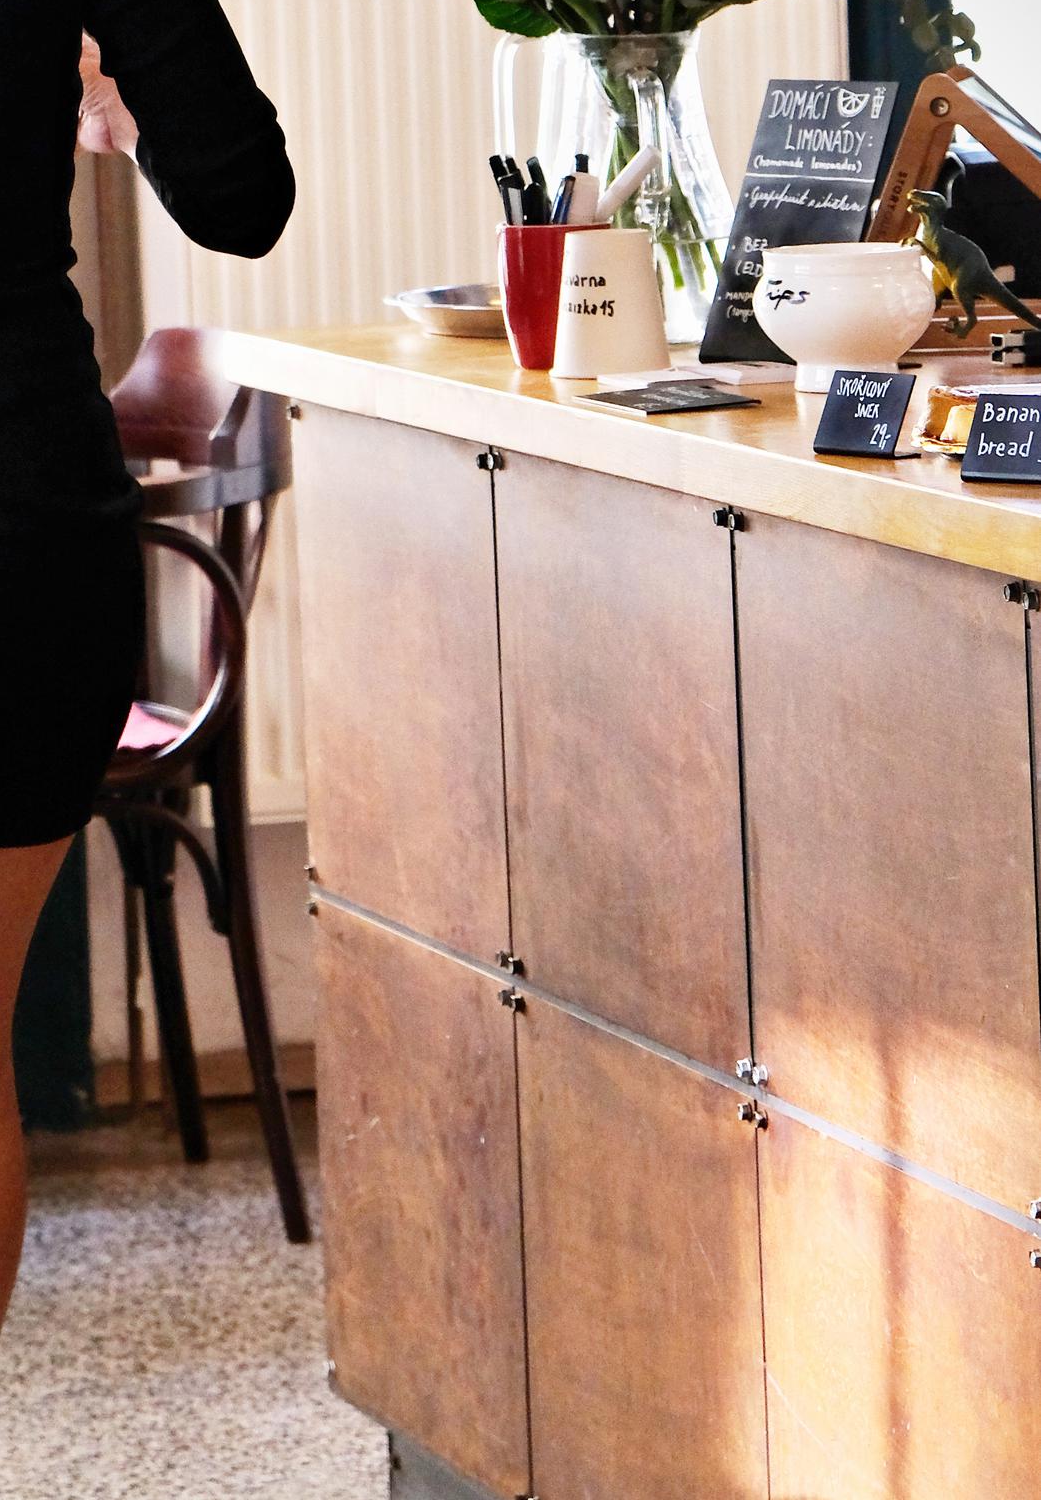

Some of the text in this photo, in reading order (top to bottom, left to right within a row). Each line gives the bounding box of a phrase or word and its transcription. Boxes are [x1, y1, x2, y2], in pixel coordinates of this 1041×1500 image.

[768, 84, 839, 119] DOMÁCÍ
[766, 279, 810, 310] Tips
[982, 402, 1040, 423] Banan
[977, 430, 1034, 457] bread
